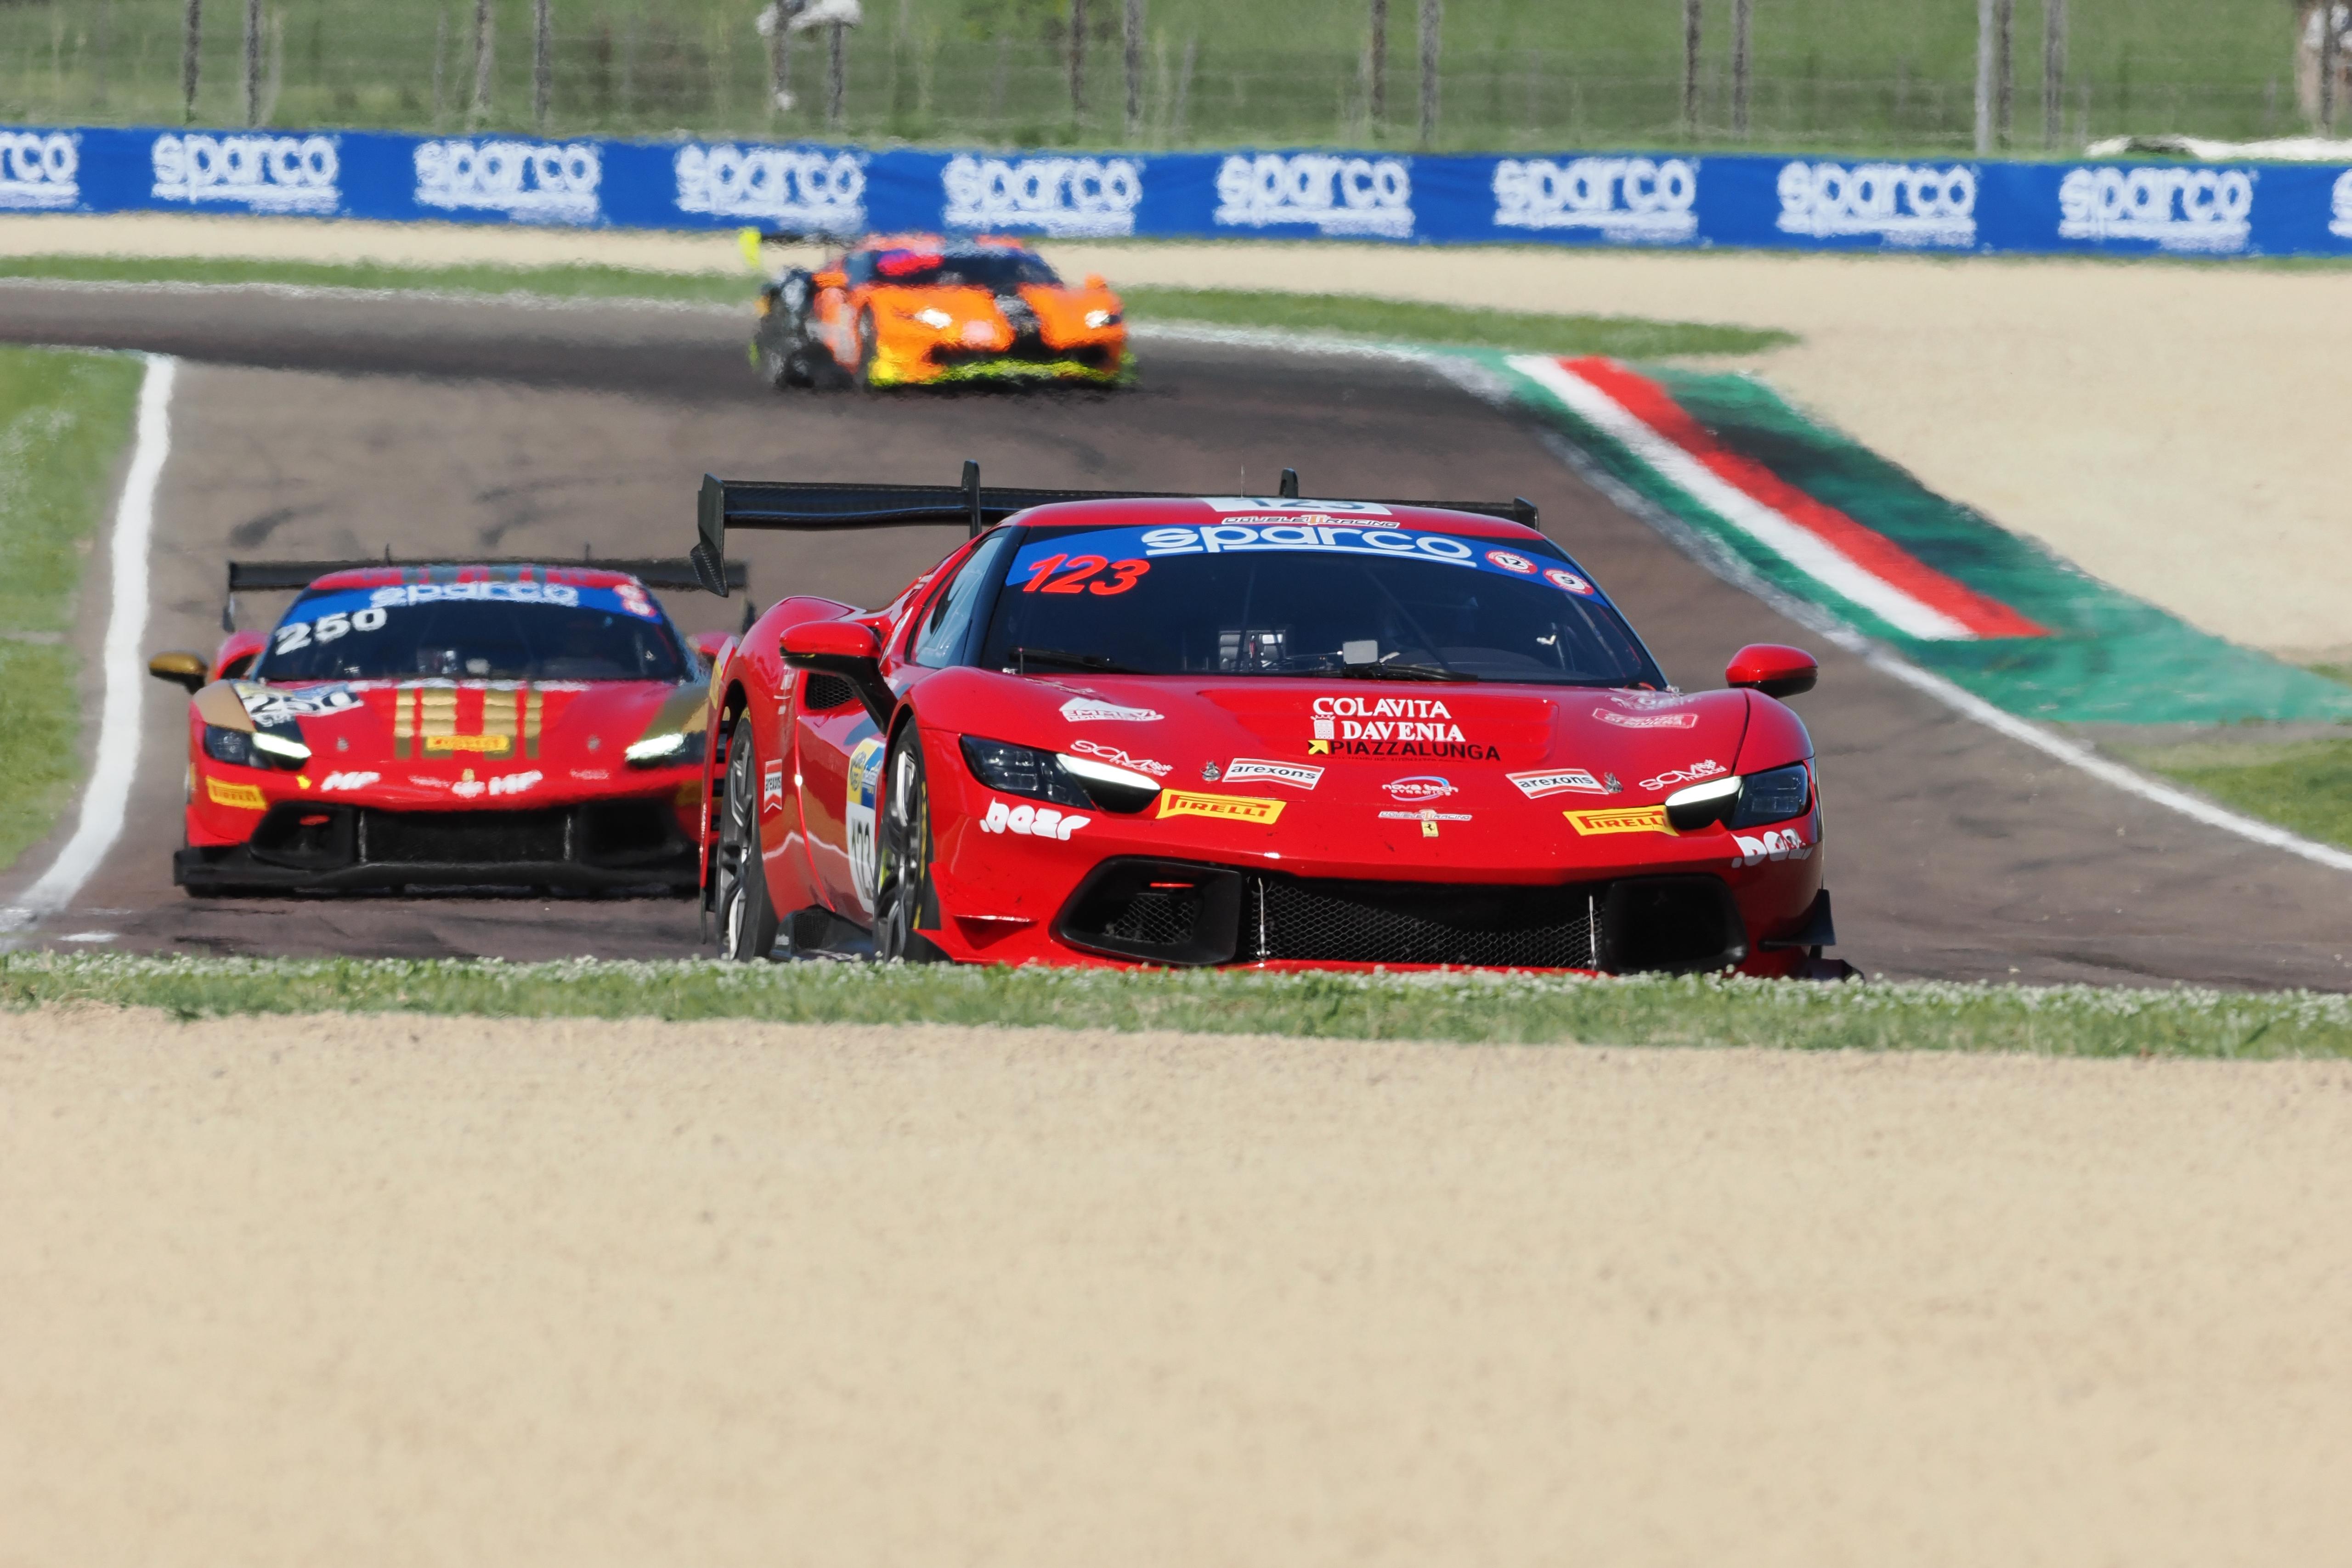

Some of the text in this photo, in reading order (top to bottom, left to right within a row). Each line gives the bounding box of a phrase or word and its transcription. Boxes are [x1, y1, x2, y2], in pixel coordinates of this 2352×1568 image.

[152, 133, 340, 202] sparco
[413, 139, 600, 210] sparco
[674, 144, 865, 217] sparco
[943, 154, 1142, 227] sparco
[1214, 154, 1414, 227] sparco
[1493, 158, 1698, 229] sparco
[1776, 161, 1976, 237] sparco
[2058, 167, 2251, 241] sparco
[1142, 525, 1476, 567] sparco
[1023, 553, 1151, 595] 123
[1498, 555, 1525, 568] 12
[370, 581, 578, 607] sparco
[276, 607, 387, 656] 250
[243, 691, 359, 714] 250
[1312, 697, 1452, 719] COLAVITA
[1341, 720, 1466, 742] DAVENIA
[1070, 740, 1153, 768] SCM
[1332, 740, 1501, 761] PIAZZALUNGA
[1231, 762, 1317, 781] arexons
[1518, 774, 1594, 789] arexons
[1639, 764, 1705, 790] SCM
[1423, 784, 1459, 793] tech
[1169, 793, 1271, 818] PIRELLI
